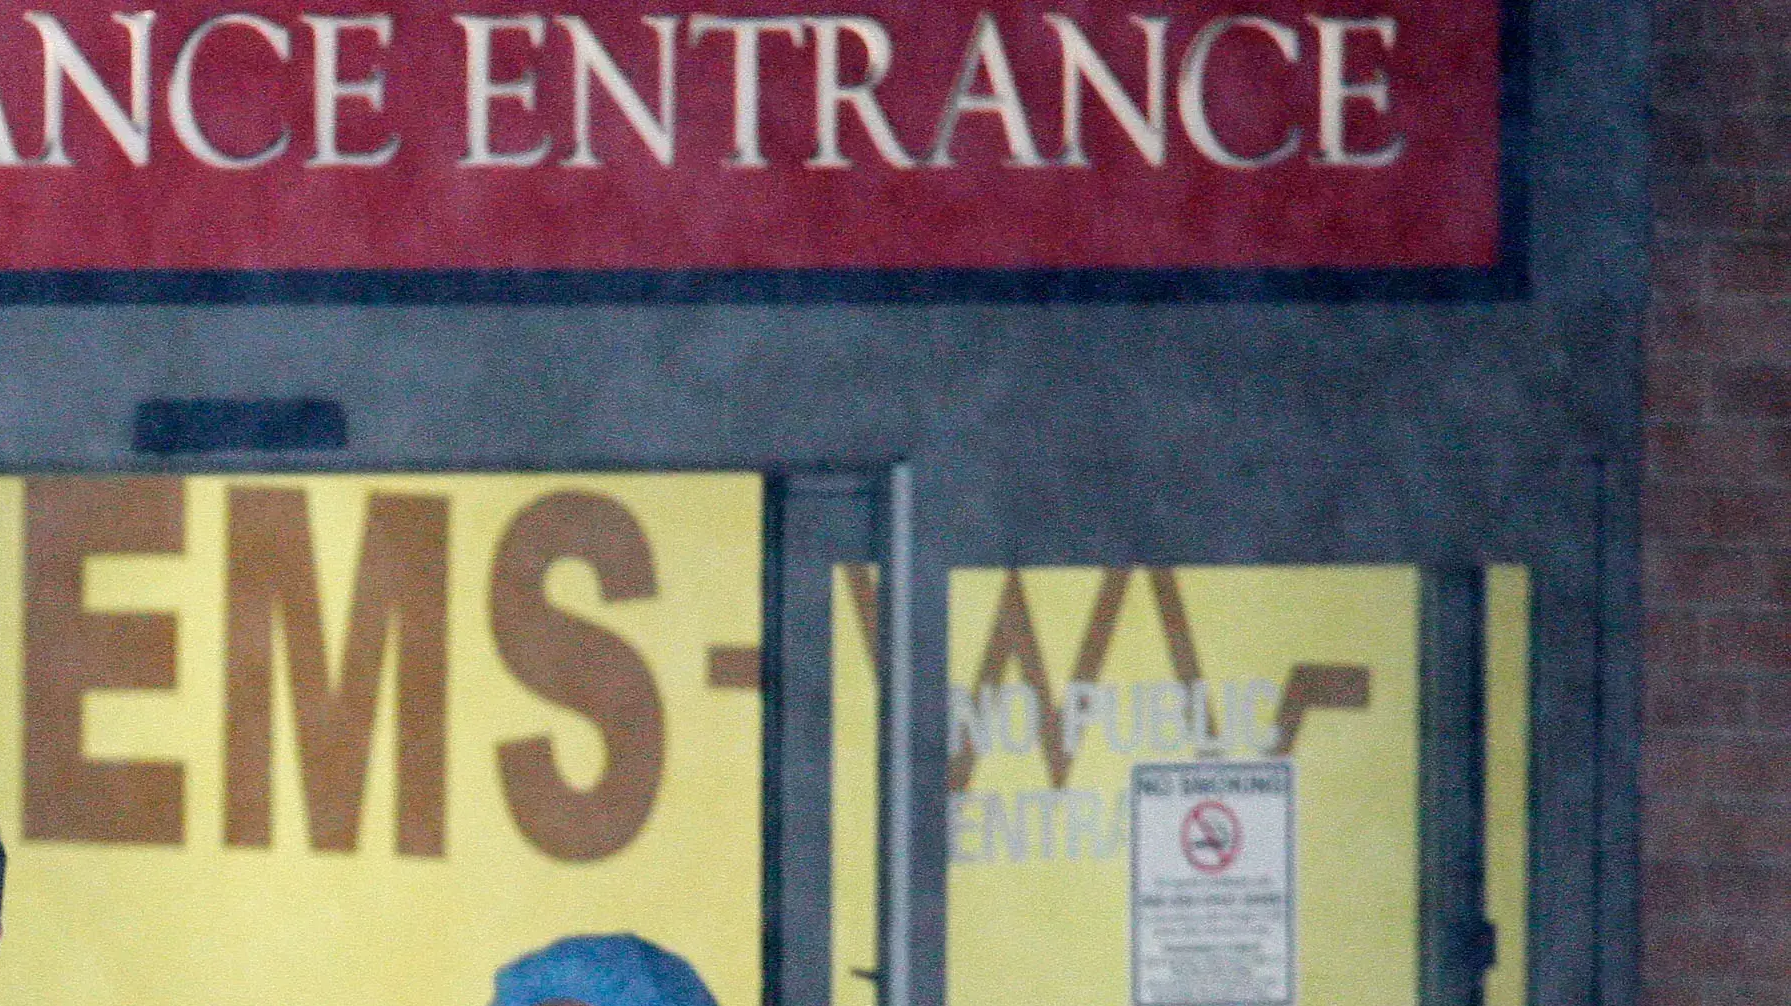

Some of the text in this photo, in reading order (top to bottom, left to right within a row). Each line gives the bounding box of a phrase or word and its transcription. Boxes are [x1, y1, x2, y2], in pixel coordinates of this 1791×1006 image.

[455, 11, 1406, 168] ENTRANCE
[945, 677, 1281, 755] NO PUBLIC
